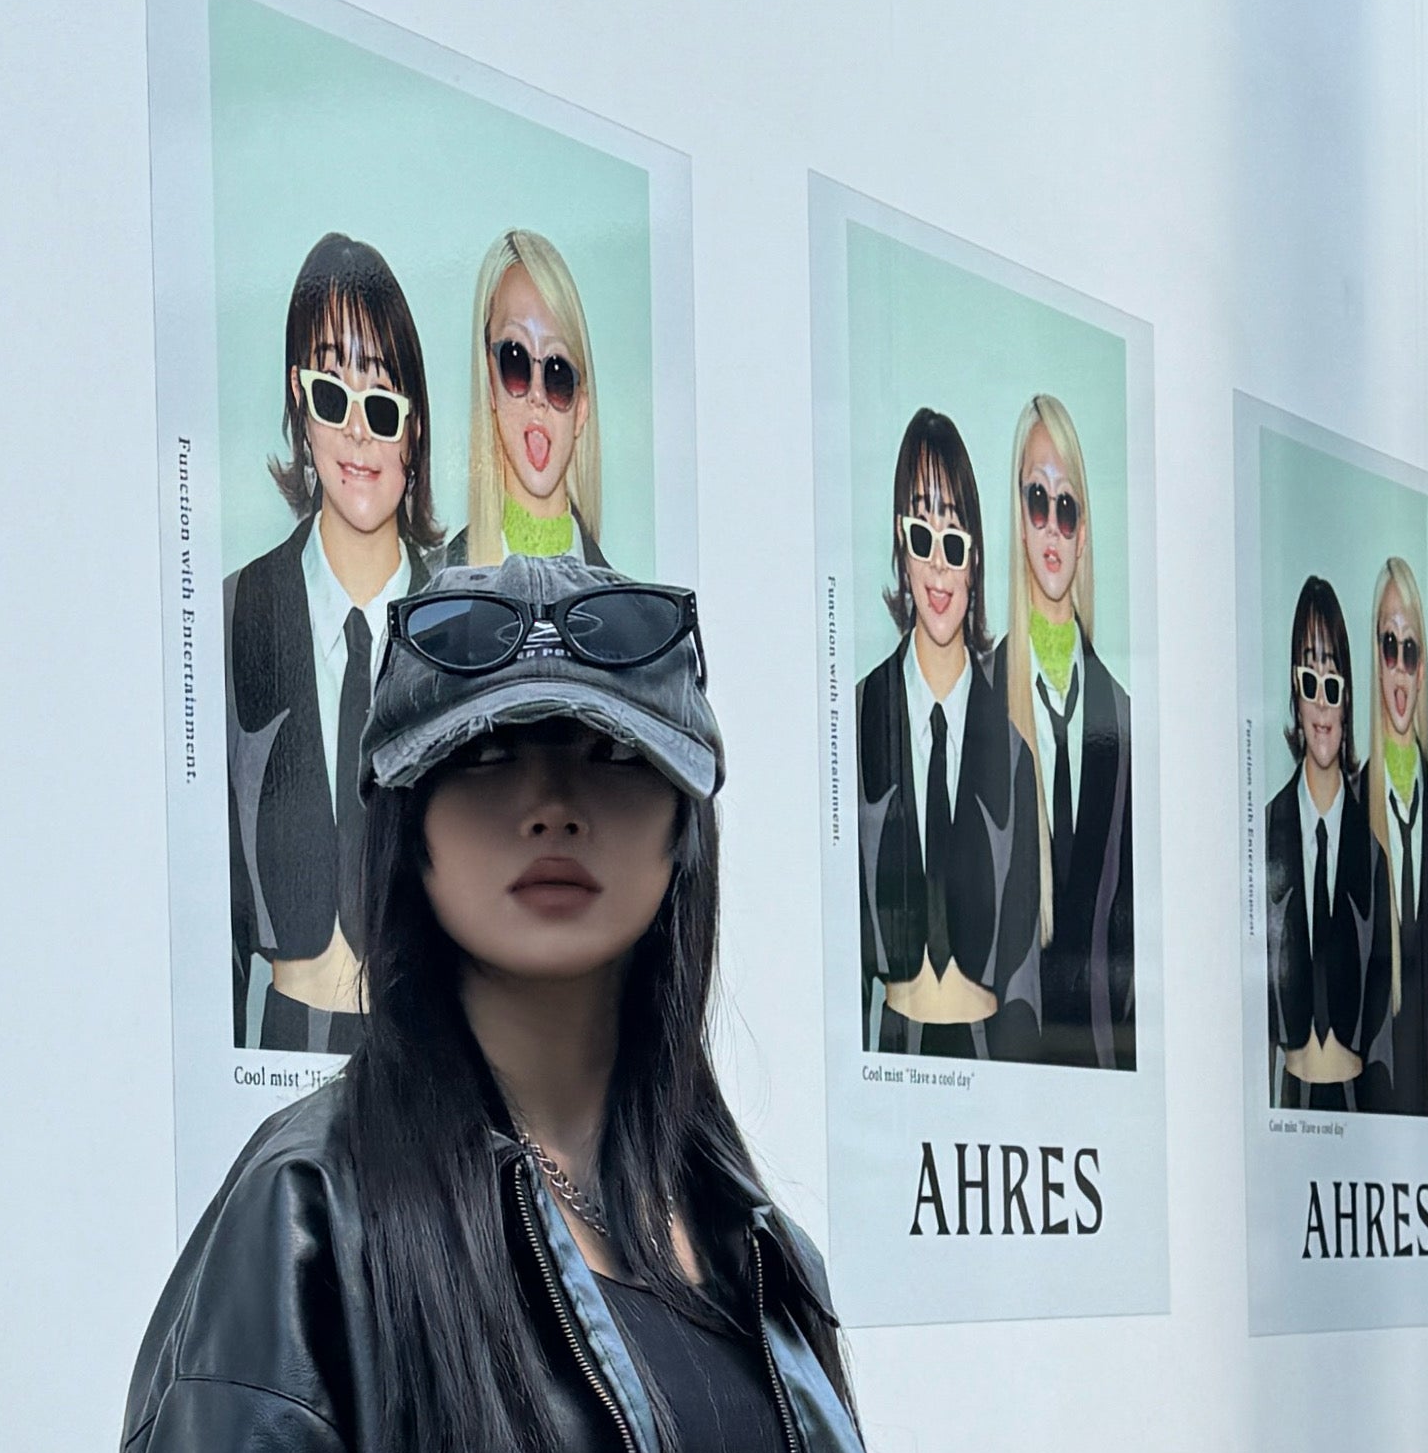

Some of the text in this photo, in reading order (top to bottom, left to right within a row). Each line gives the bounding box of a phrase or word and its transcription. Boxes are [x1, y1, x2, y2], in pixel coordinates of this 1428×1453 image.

[178, 436, 191, 541] Function
[182, 549, 195, 600] with
[234, 1066, 266, 1087] Cool
[270, 1069, 300, 1088] mist
[909, 1142, 1103, 1236] AHRES
